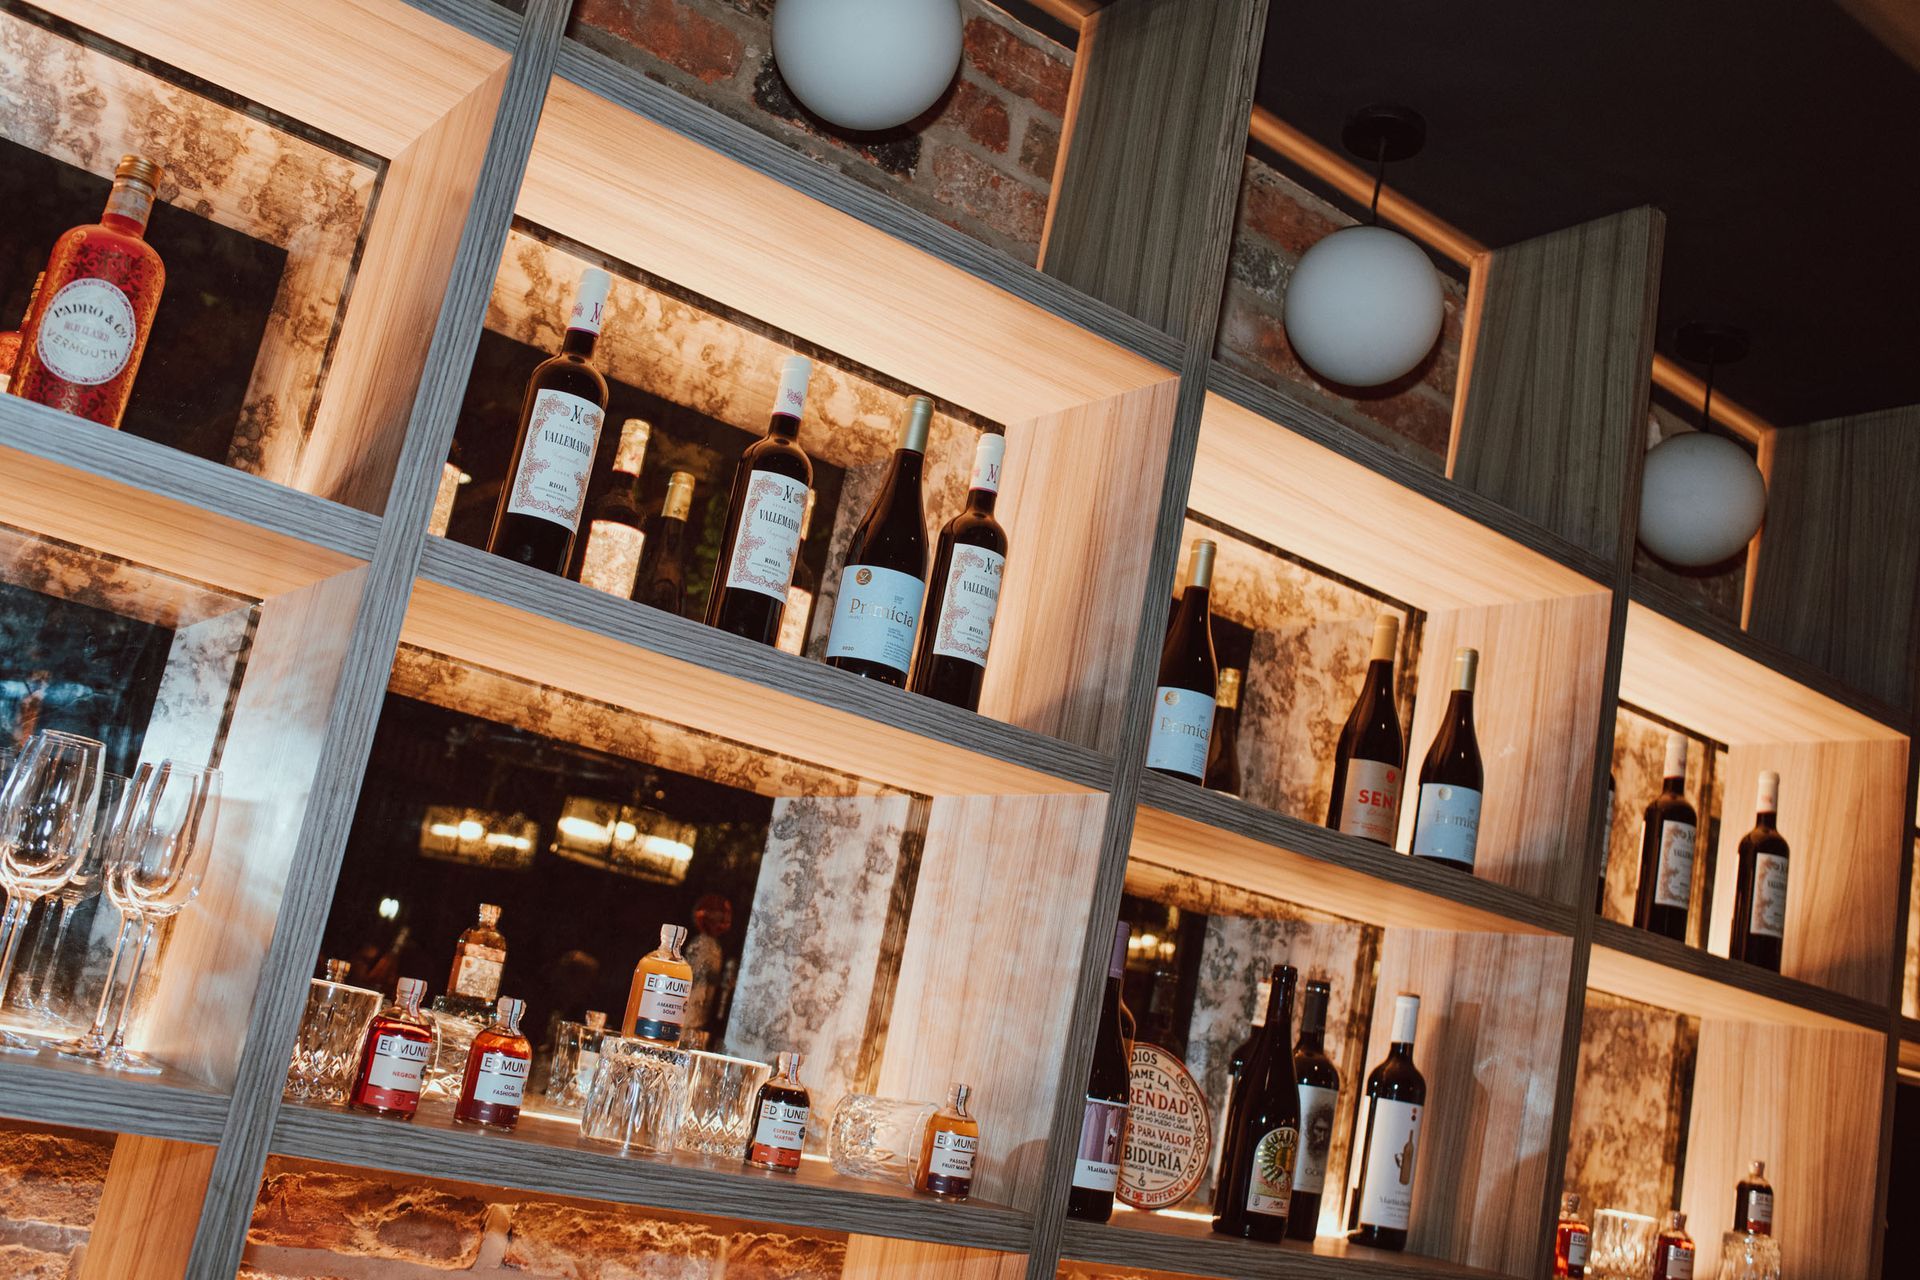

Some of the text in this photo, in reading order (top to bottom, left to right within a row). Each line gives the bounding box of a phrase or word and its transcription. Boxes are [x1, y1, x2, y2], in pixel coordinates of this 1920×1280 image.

[46, 327, 119, 360] VERMOUTH
[544, 430, 591, 457] VALLEMAYOR
[548, 481, 567, 493] RIOJA
[764, 556, 781, 568] RIOJA
[1143, 1081, 1153, 1090] LA
[1157, 1073, 1170, 1092] LA
[1137, 1124, 1156, 1139] PARA
[1158, 1129, 1192, 1148] VALOR
[949, 1157, 968, 1166] PASSION
[1087, 1165, 1109, 1175] Matilda
